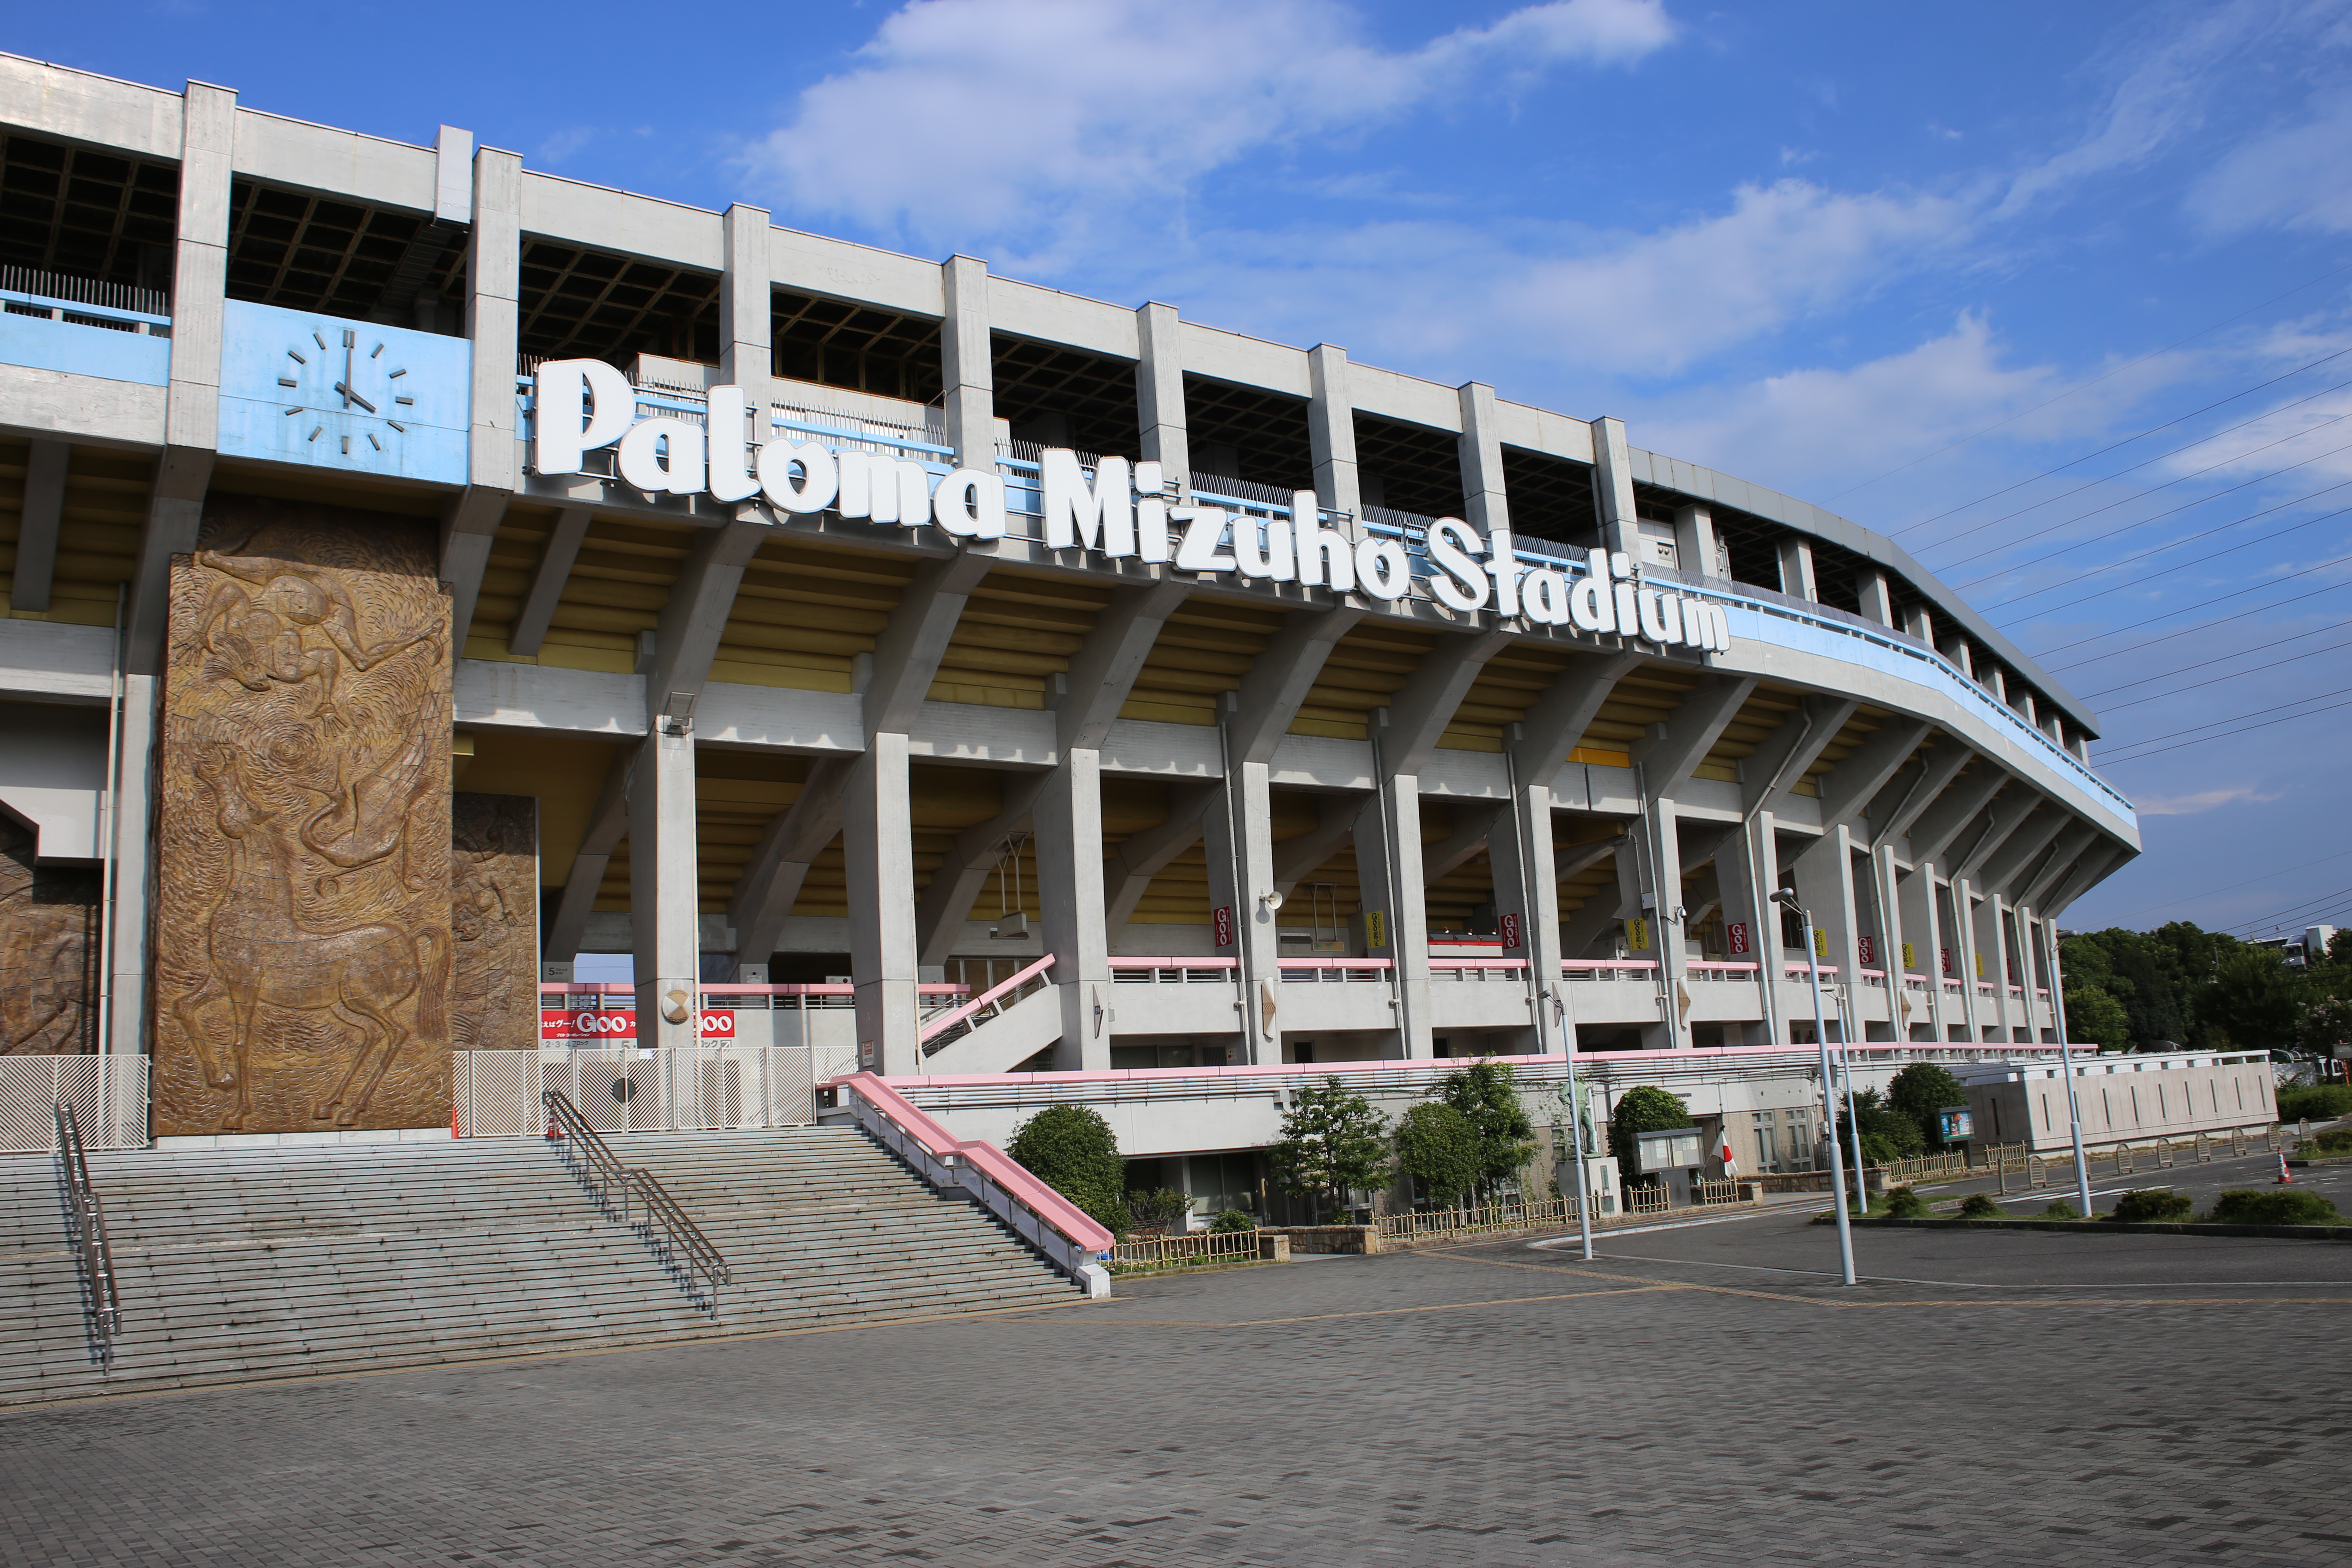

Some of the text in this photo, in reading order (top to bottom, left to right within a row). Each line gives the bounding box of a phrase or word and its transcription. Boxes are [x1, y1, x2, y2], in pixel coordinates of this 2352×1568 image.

[537, 358, 1731, 652] Paloma Mizuho Stadium
[548, 967, 555, 976] 5
